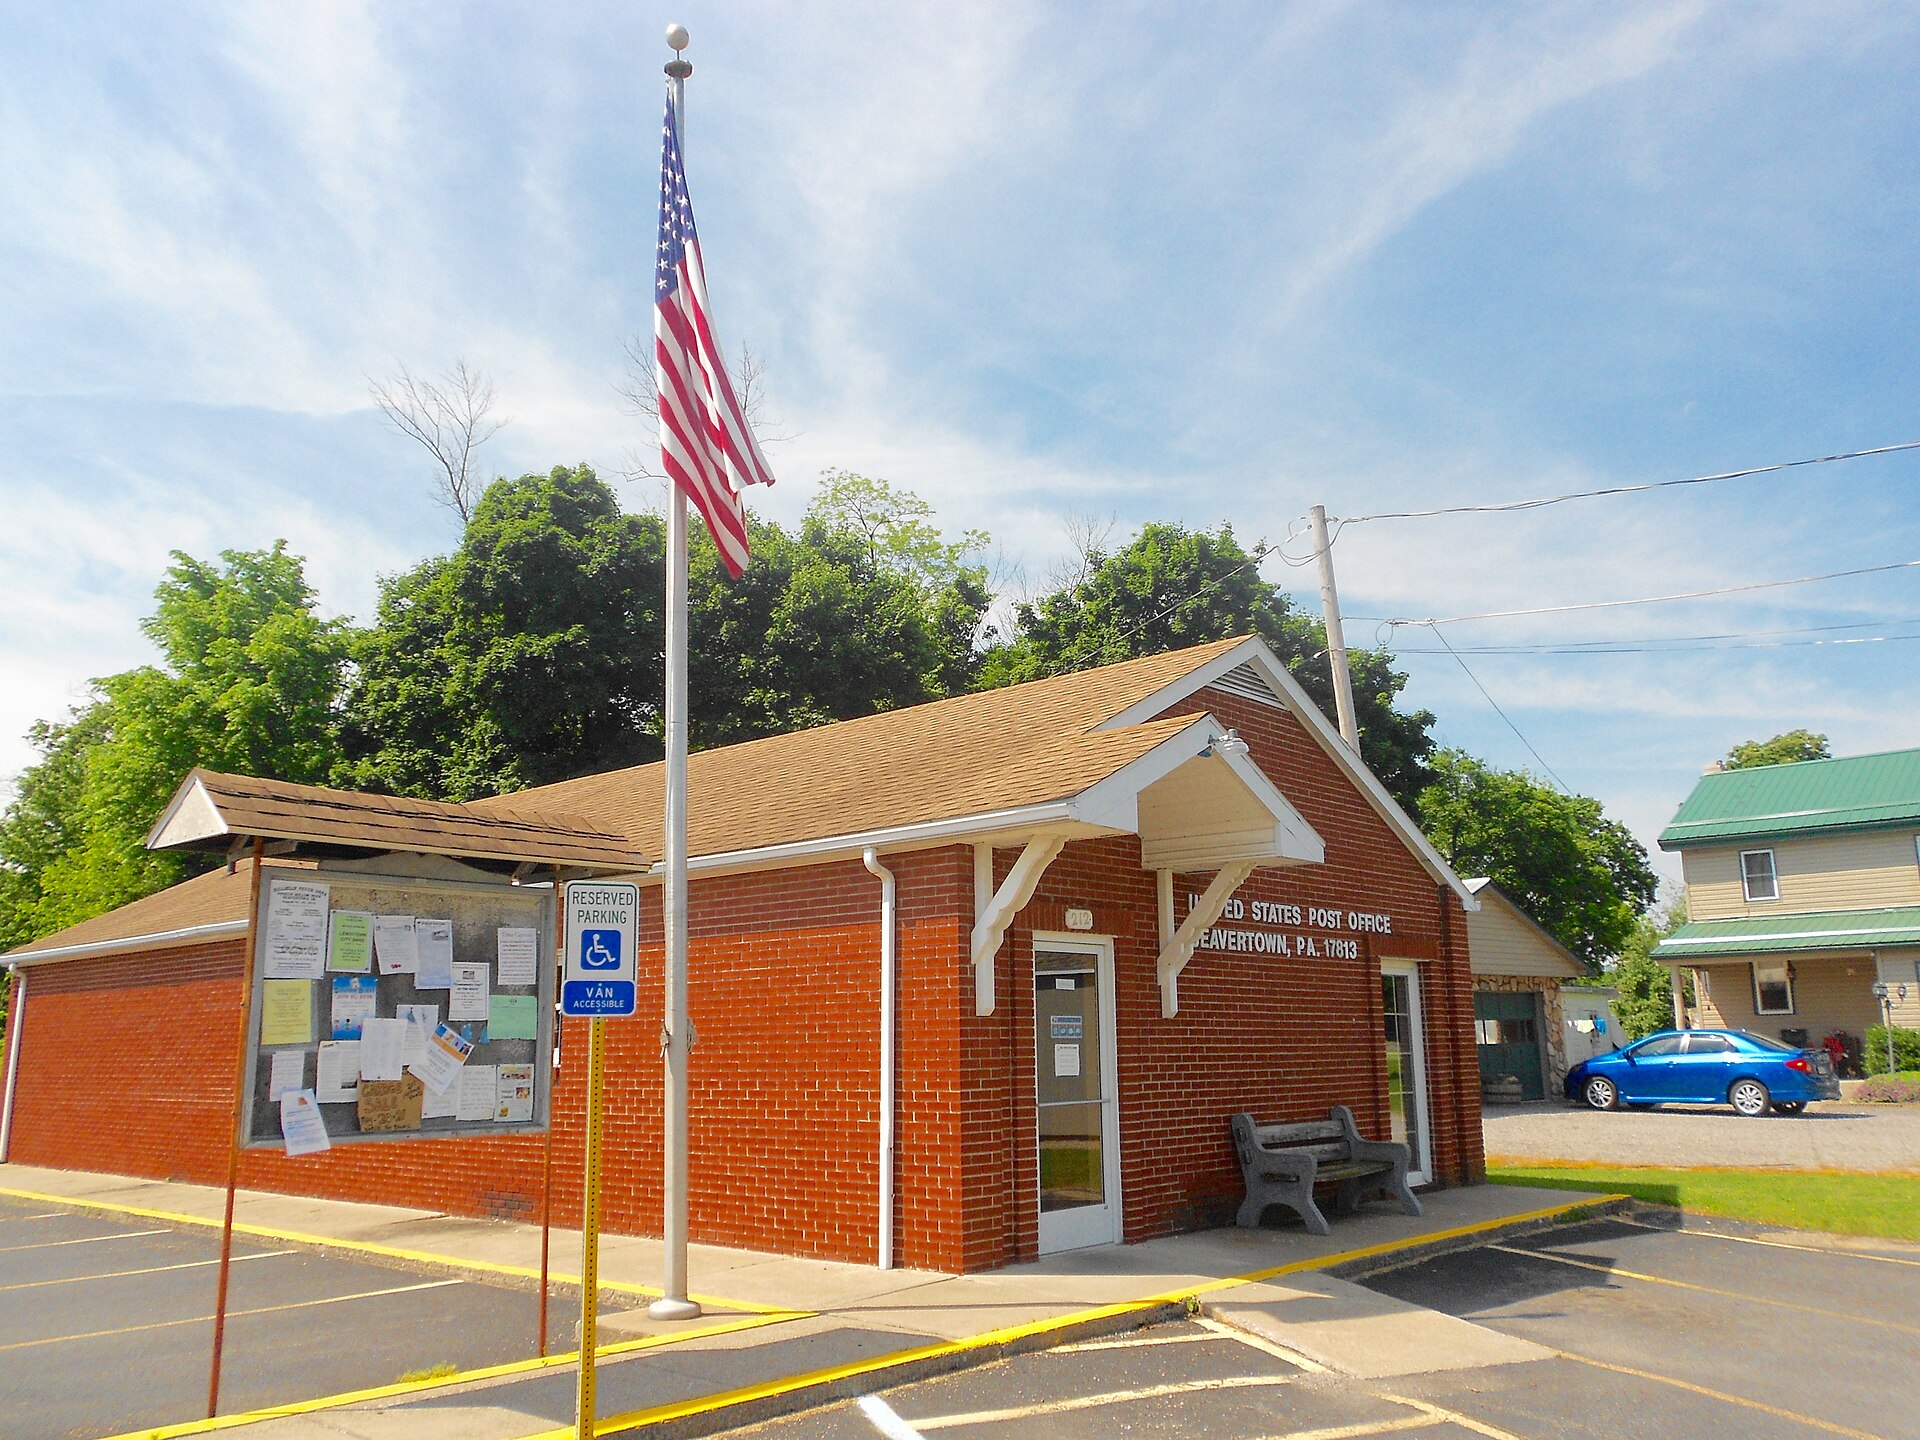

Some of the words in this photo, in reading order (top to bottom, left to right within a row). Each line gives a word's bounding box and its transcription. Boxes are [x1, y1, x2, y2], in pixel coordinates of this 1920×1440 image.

[572, 891, 633, 906] RESERVED
[577, 910, 627, 924] PARKING
[1071, 912, 1090, 926] 212
[1188, 893, 1244, 919] UED
[1252, 901, 1302, 926] STATES
[1308, 907, 1342, 929] POST
[1347, 911, 1392, 935] OFFICE
[1193, 928, 1291, 958] EAVERTOWN,
[1297, 936, 1321, 957] PA.
[1323, 938, 1358, 960] 17813
[586, 987, 614, 998] VAN
[573, 1000, 625, 1008] ACCESSIBLE
